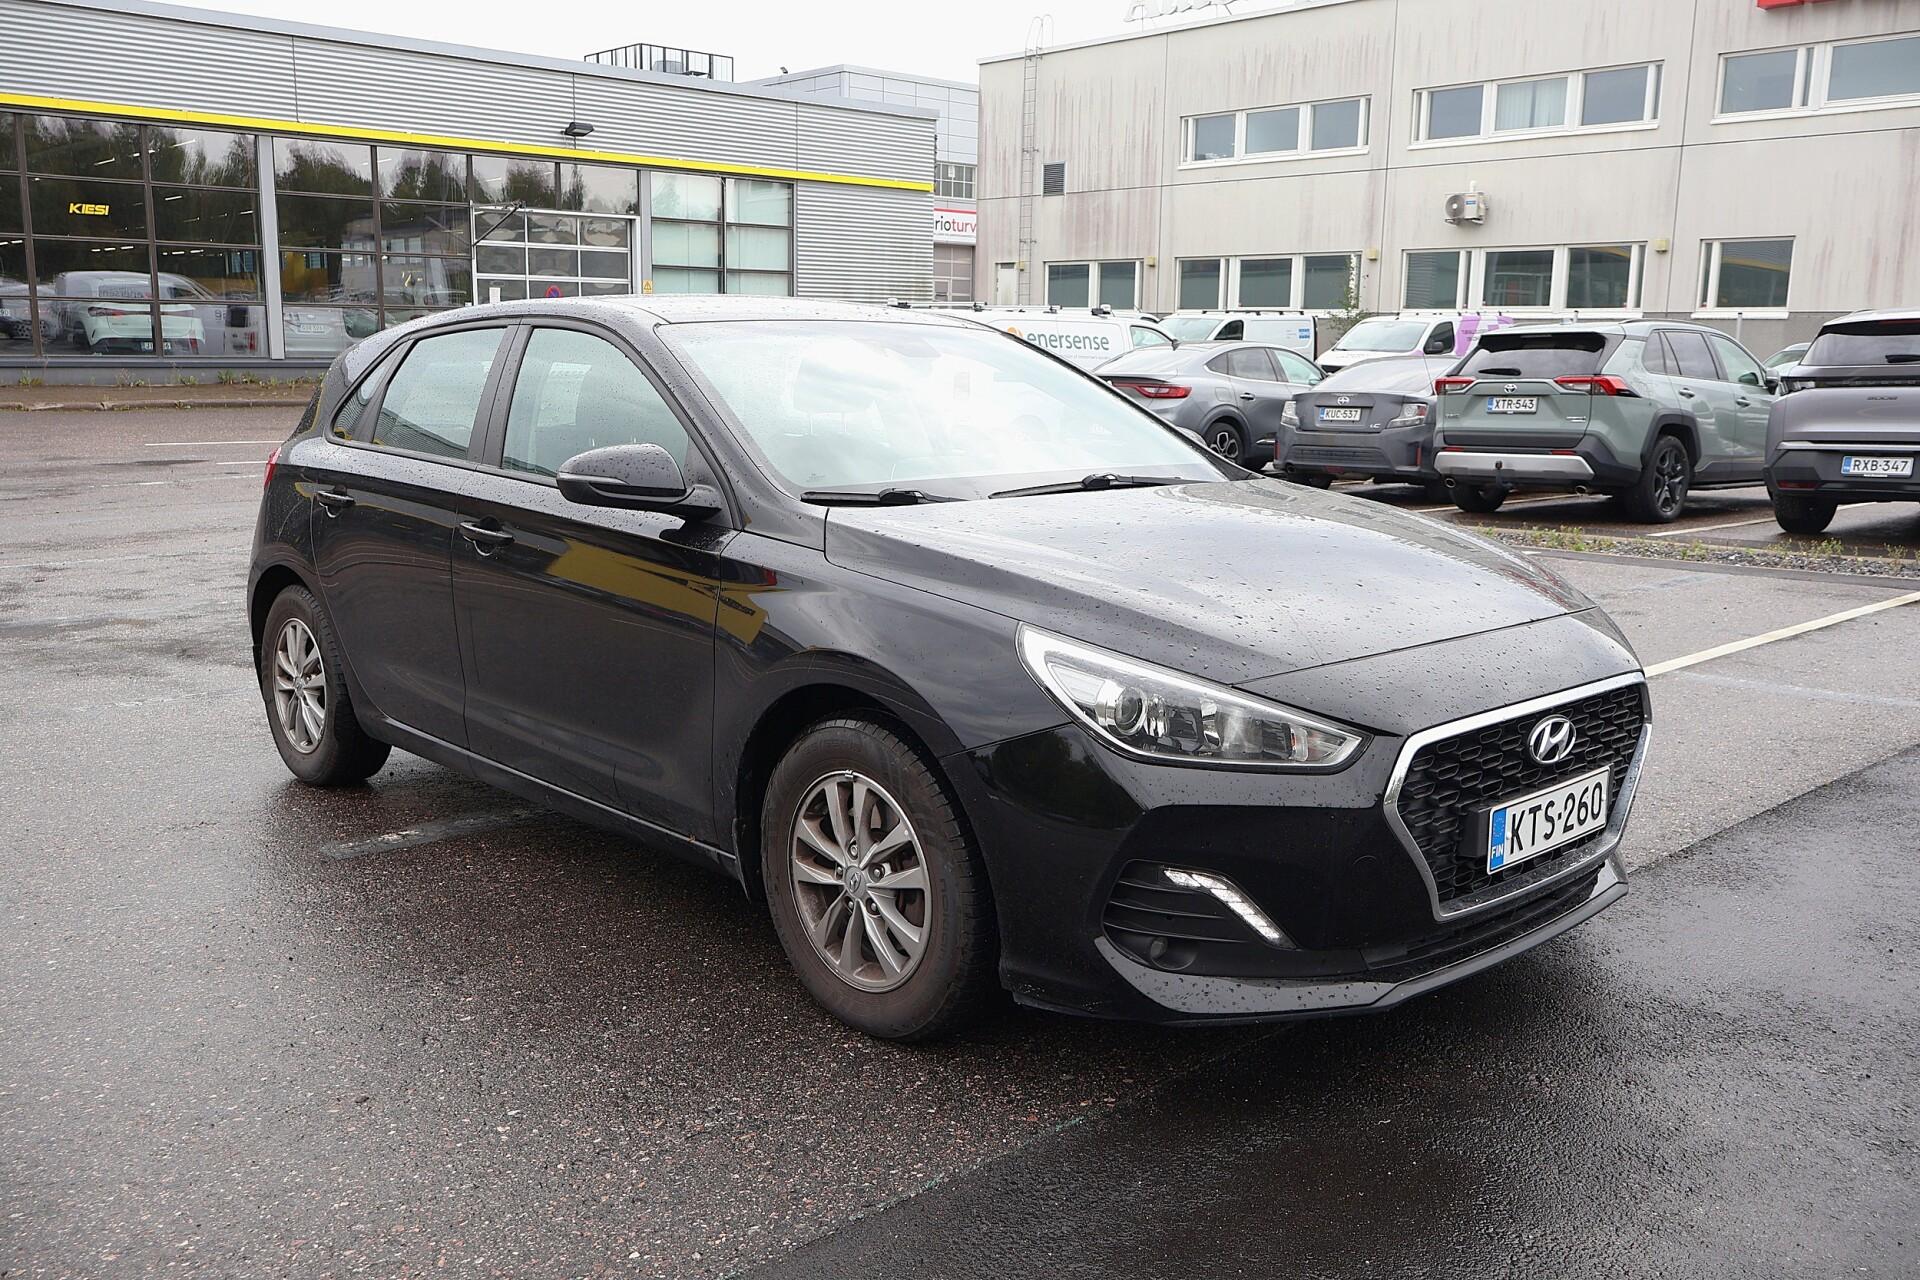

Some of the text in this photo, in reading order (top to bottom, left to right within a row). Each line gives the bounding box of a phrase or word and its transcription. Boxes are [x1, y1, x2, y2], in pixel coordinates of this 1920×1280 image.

[69, 203, 110, 216] KIESI
[1027, 332, 1110, 351] enersense
[1494, 398, 1535, 410] XTR-543
[1853, 459, 1908, 472] RXB-347
[1510, 781, 1603, 855] KTS-260
[1490, 843, 1505, 860] FIN
